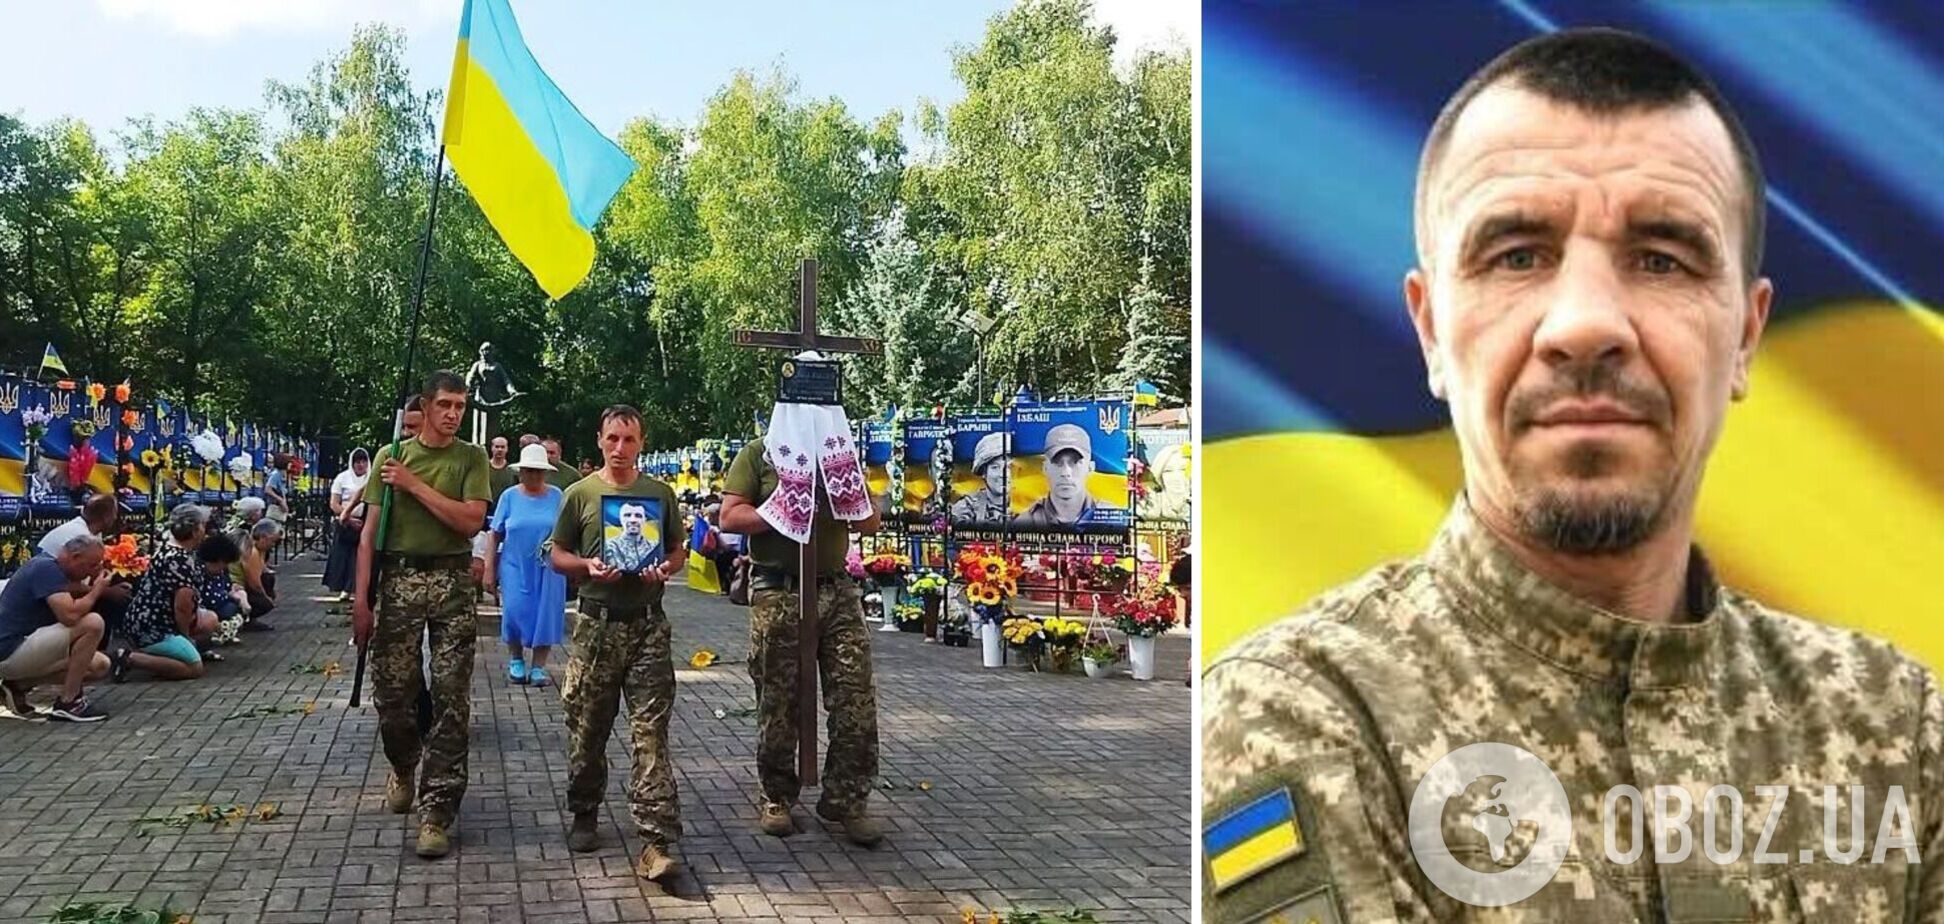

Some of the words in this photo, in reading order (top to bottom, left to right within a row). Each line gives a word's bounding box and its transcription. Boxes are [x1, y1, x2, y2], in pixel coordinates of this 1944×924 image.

[1017, 412, 1050, 423] ІЗБАШ
[1016, 532, 1046, 543] ВІЧНА
[1048, 532, 1081, 543] СЛАВА
[1083, 533, 1123, 545] ГЕРОЮ!
